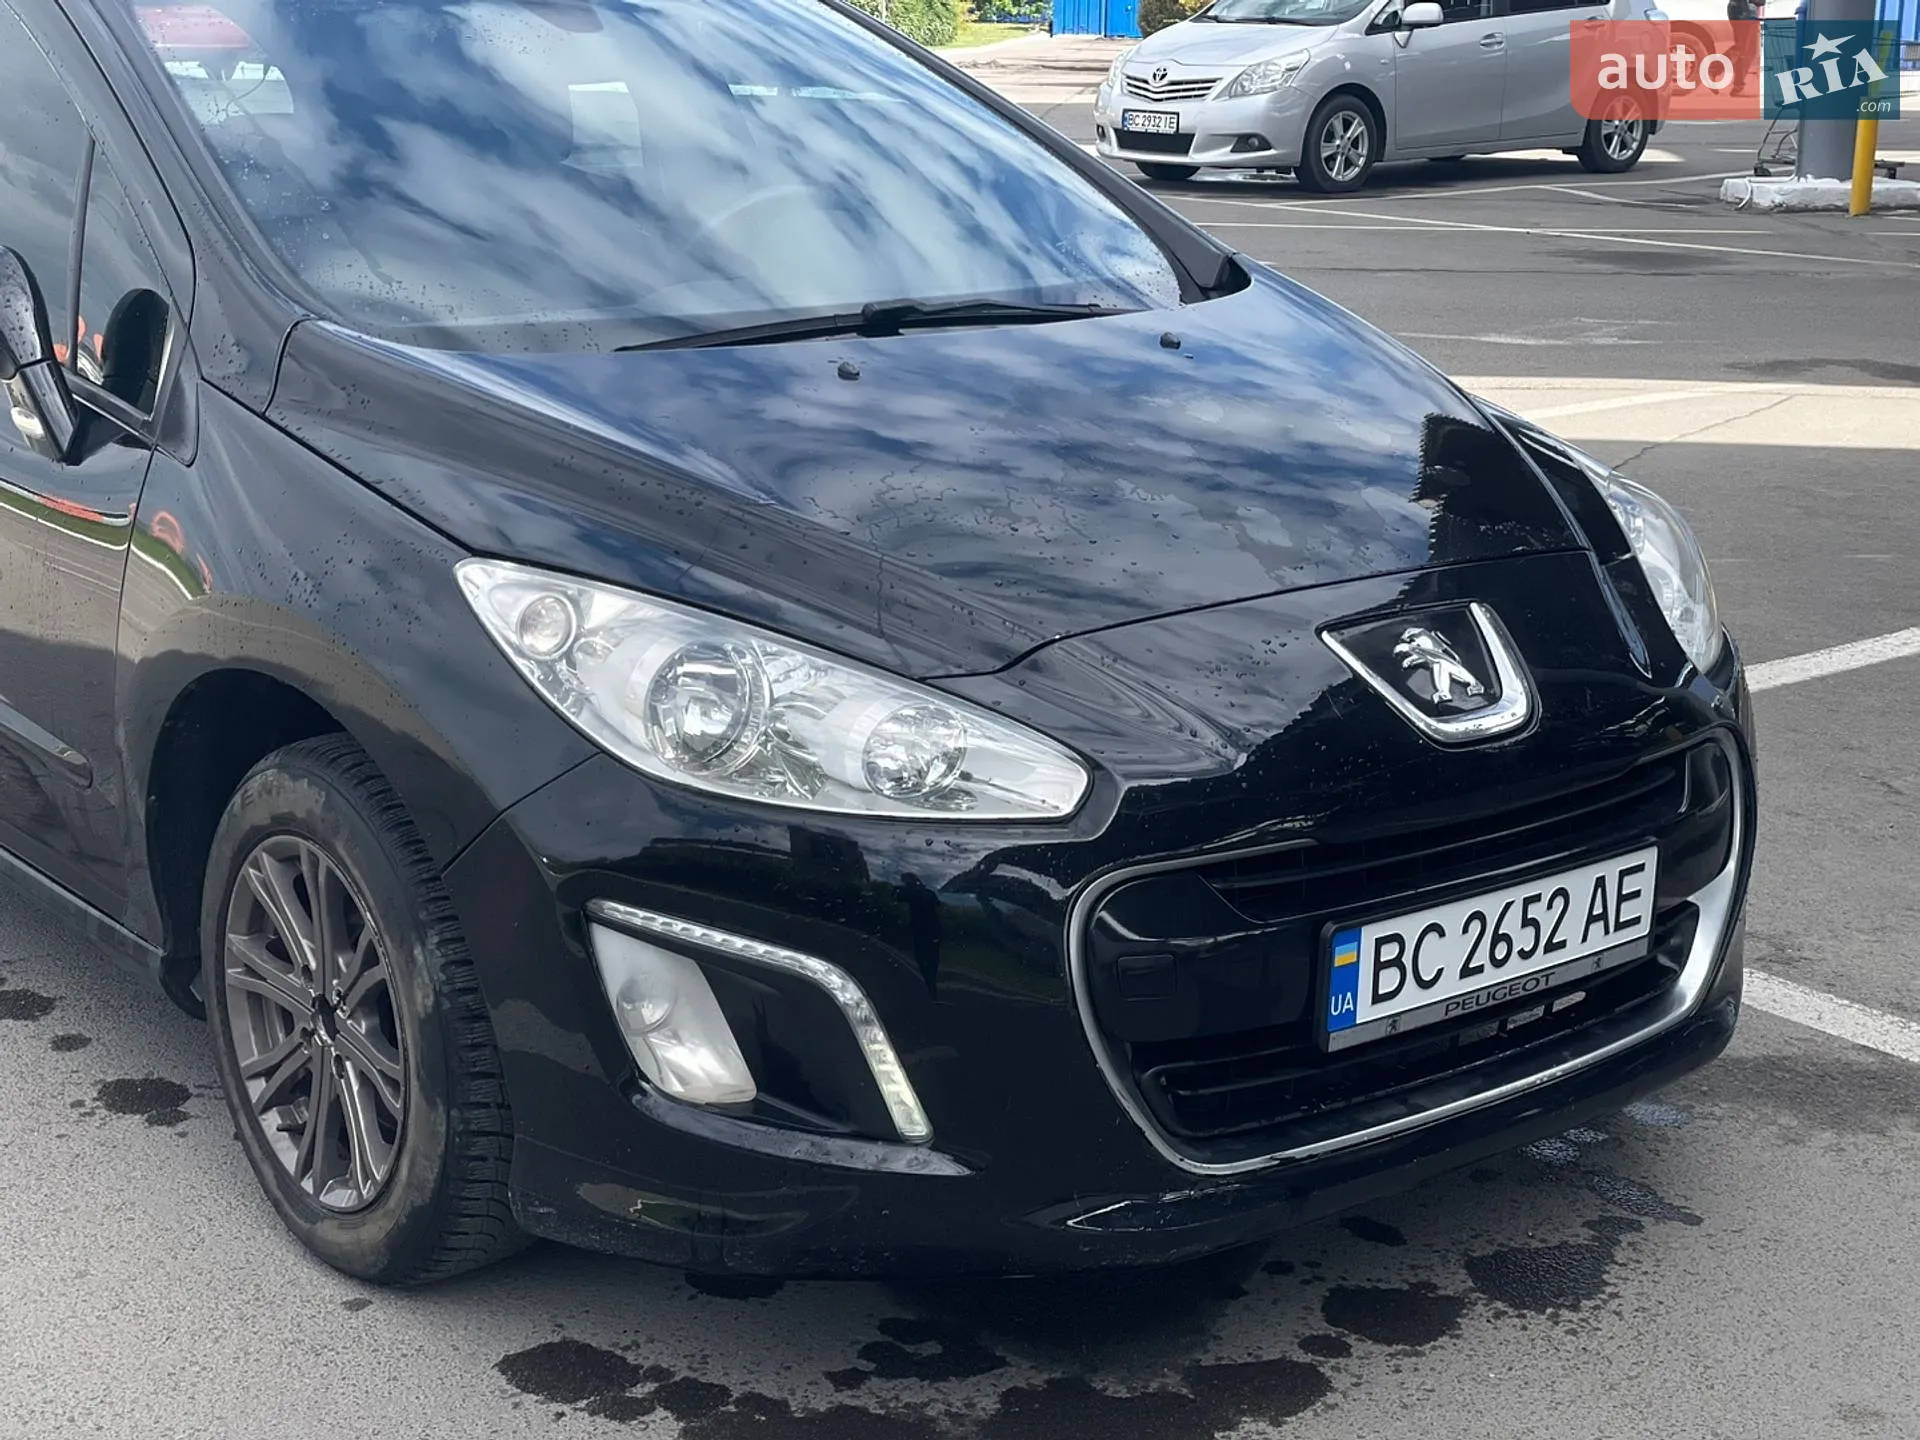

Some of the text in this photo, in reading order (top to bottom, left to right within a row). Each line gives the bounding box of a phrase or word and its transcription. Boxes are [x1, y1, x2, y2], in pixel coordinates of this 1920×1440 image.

[1128, 113, 1176, 129] BC 2932 IE
[1371, 862, 1646, 1006] BC 2652 AE
[1330, 992, 1355, 1017] UA
[1443, 971, 1556, 1017] PEUGEOT
